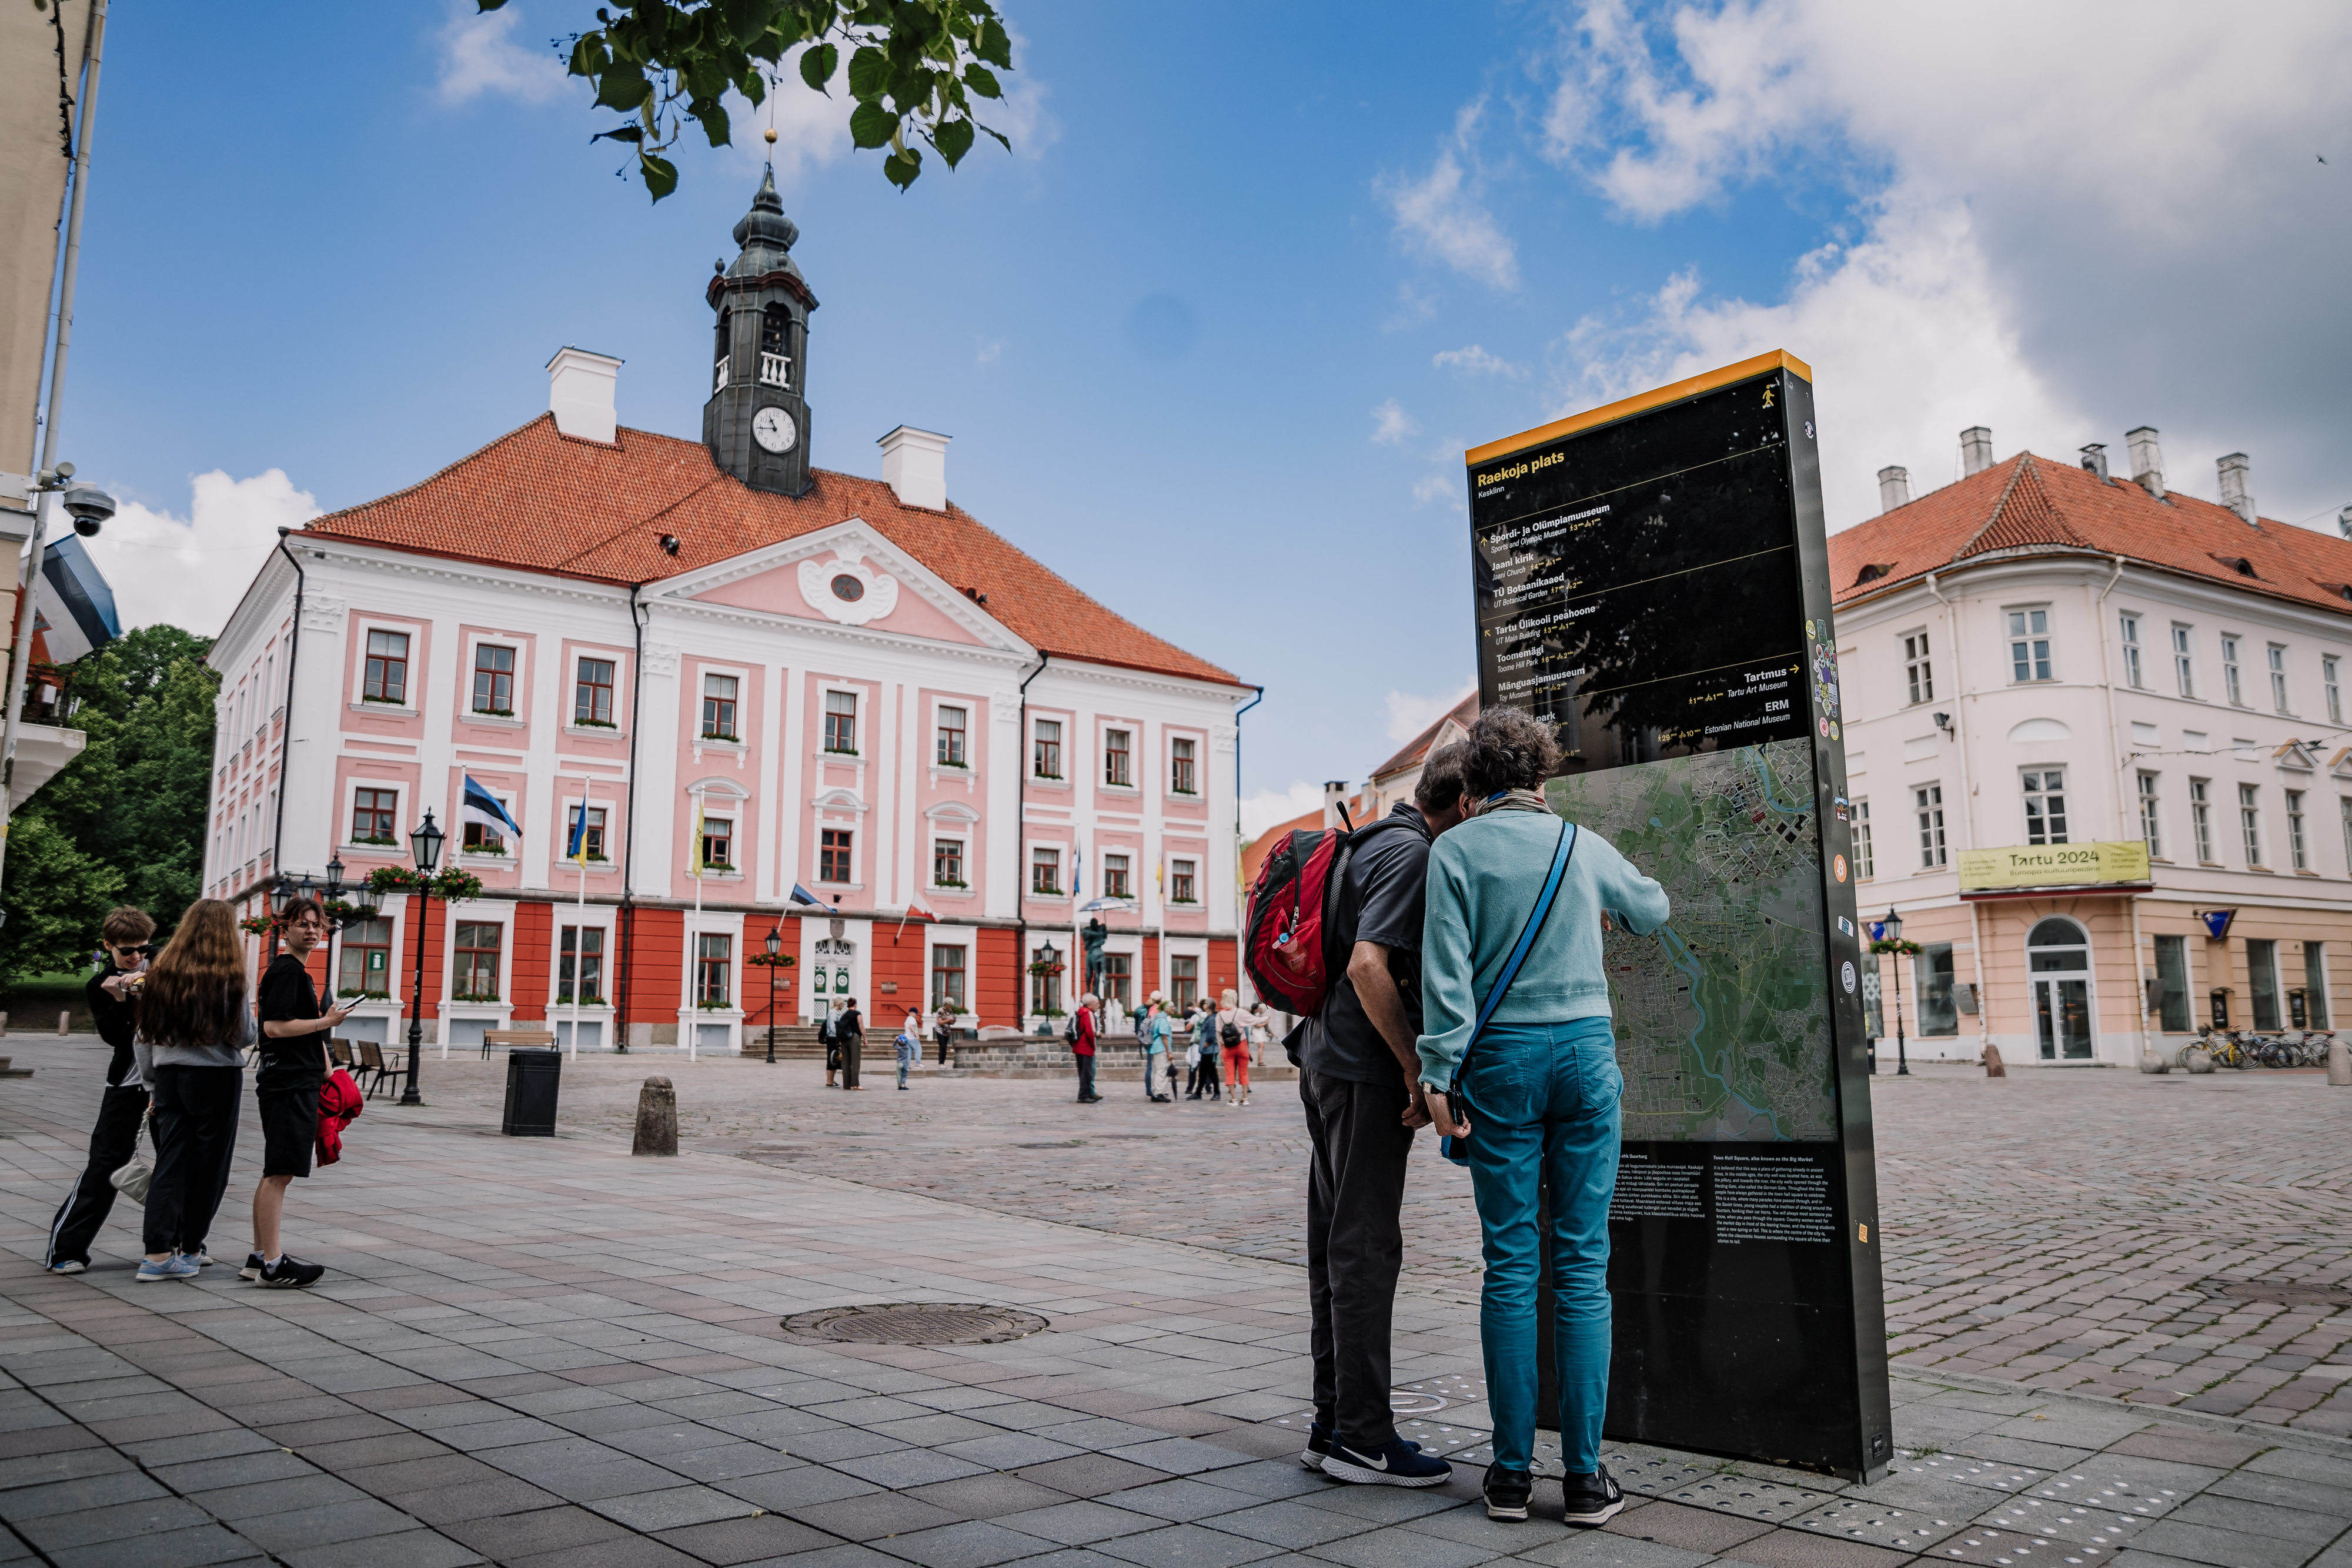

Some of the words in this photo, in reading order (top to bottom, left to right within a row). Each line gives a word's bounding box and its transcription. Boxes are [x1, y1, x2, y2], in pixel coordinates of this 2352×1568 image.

[1478, 463, 1528, 487] Raekoja
[1531, 452, 1564, 473] plats
[1478, 486, 1504, 499] Kesklinn
[1490, 528, 1521, 544] Spordi-
[1522, 526, 1530, 537] ja
[1532, 504, 1610, 531] Olümpiamuuseum
[1491, 544, 1508, 554] Sports
[1508, 539, 1519, 548] and
[1520, 534, 1542, 546] Olympic
[1543, 527, 1566, 539] Museum
[1492, 557, 1512, 571] Jaani
[1515, 552, 1534, 564] kirik
[1492, 570, 1506, 581] Jaani
[1506, 566, 1526, 577] Church
[1492, 586, 1505, 598] TÜ
[1506, 572, 1565, 595] Botaanikaaed
[1494, 599, 1502, 608] UT
[1502, 593, 1527, 607] Botanical
[1528, 589, 1548, 600] Garden
[1495, 624, 1517, 635] Tartu
[1519, 614, 1551, 629] Ülikooli
[1553, 606, 1596, 623] peahoone
[1496, 636, 1504, 645] UT
[1504, 634, 1518, 643] Main
[1519, 629, 1541, 640] Building
[1496, 644, 1544, 663] Toomemägi
[1497, 664, 1515, 673] Toome
[1515, 660, 1525, 669] Hill
[1526, 657, 1538, 667] Park
[1498, 664, 1585, 691] Mänguasjamuuseum
[1743, 668, 1787, 683] Tartmus
[1499, 694, 1508, 703] Toy
[1509, 690, 1532, 700] Museum
[1727, 688, 1744, 697] Tartu
[1746, 686, 1757, 694] Art
[1759, 681, 1788, 691] Museum
[1765, 698, 1789, 711] ERM
[1536, 711, 1556, 724] park
[1705, 723, 1732, 734] Estonian
[1733, 717, 1760, 729] National
[1762, 714, 1790, 724] Museum
[2057, 850, 2099, 864] 2024
[2043, 865, 2100, 875] kultuuripealinn
